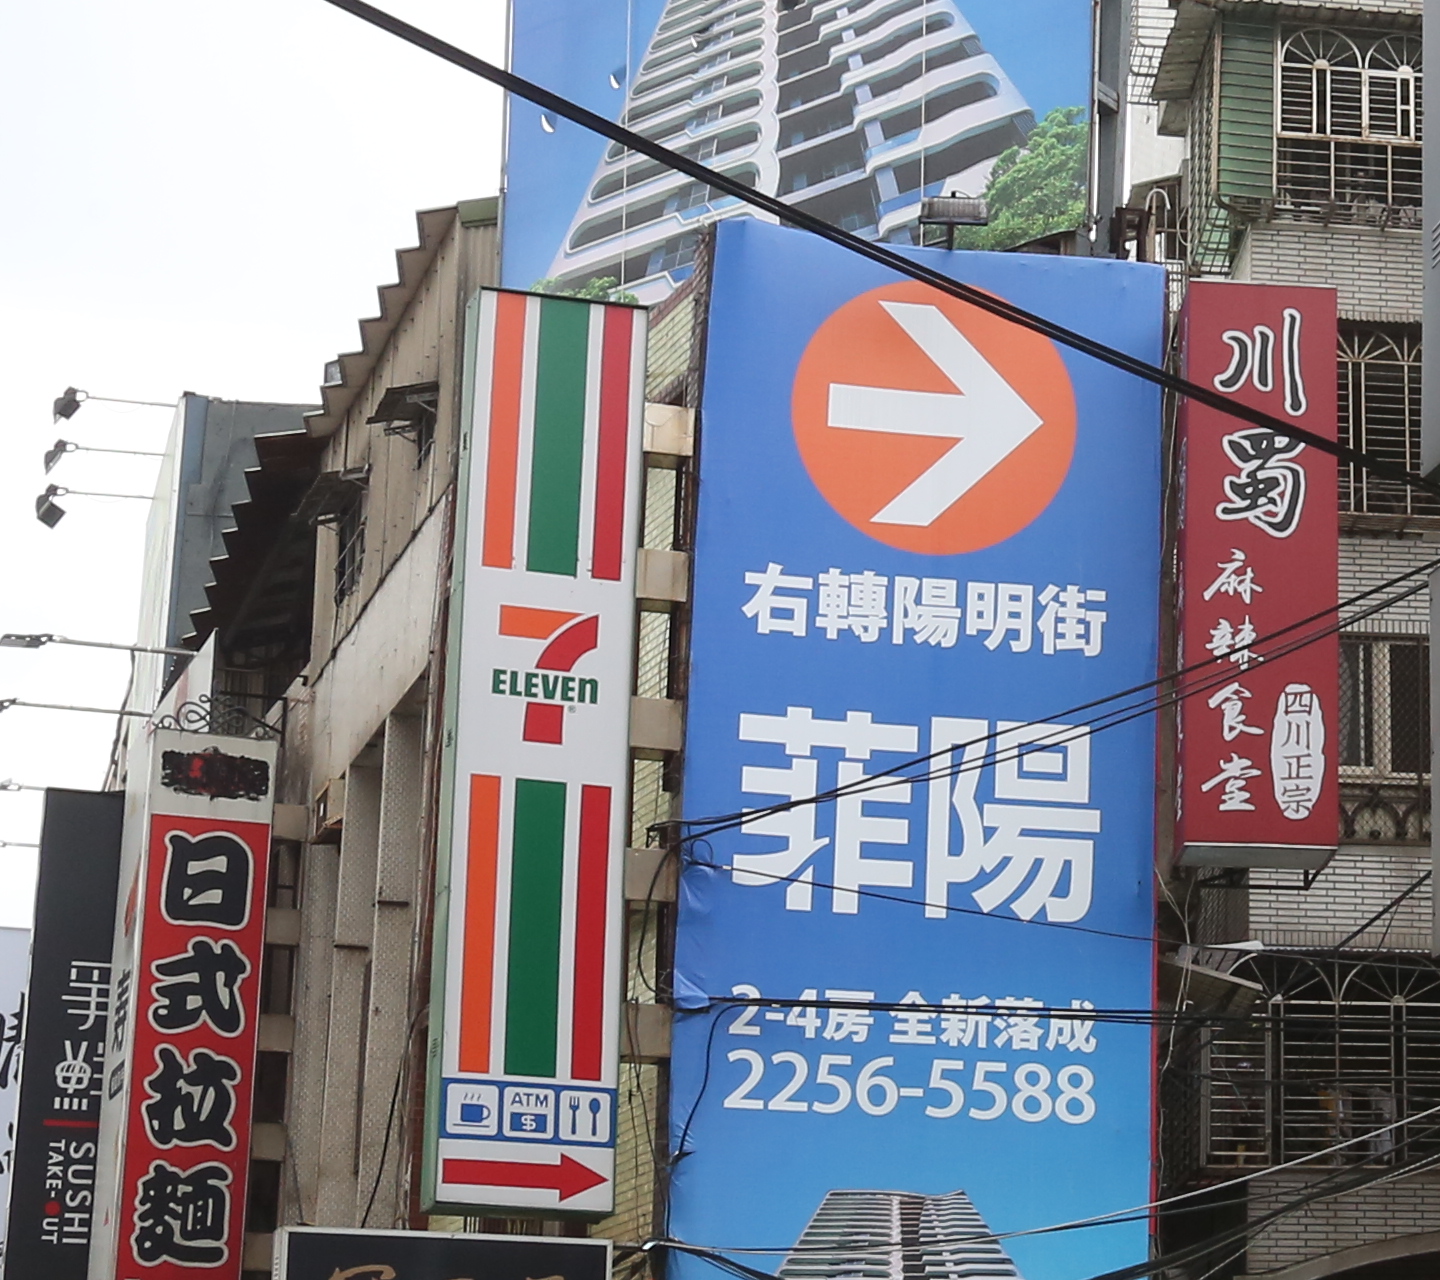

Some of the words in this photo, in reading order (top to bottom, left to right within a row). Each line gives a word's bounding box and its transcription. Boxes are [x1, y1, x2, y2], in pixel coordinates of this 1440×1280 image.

[741, 562, 1107, 657] 右轉陽明街
[1279, 689, 1319, 817] 四川正宗
[733, 706, 1102, 924] 菲陽
[131, 830, 254, 1267] 日式拉麵
[728, 983, 875, 1043] 2-4房
[888, 992, 1098, 1054] 全新落成
[509, 1092, 549, 1111] ATM
[723, 1047, 1096, 1125] 2256-5588
[62, 1140, 95, 1244] SUSHI
